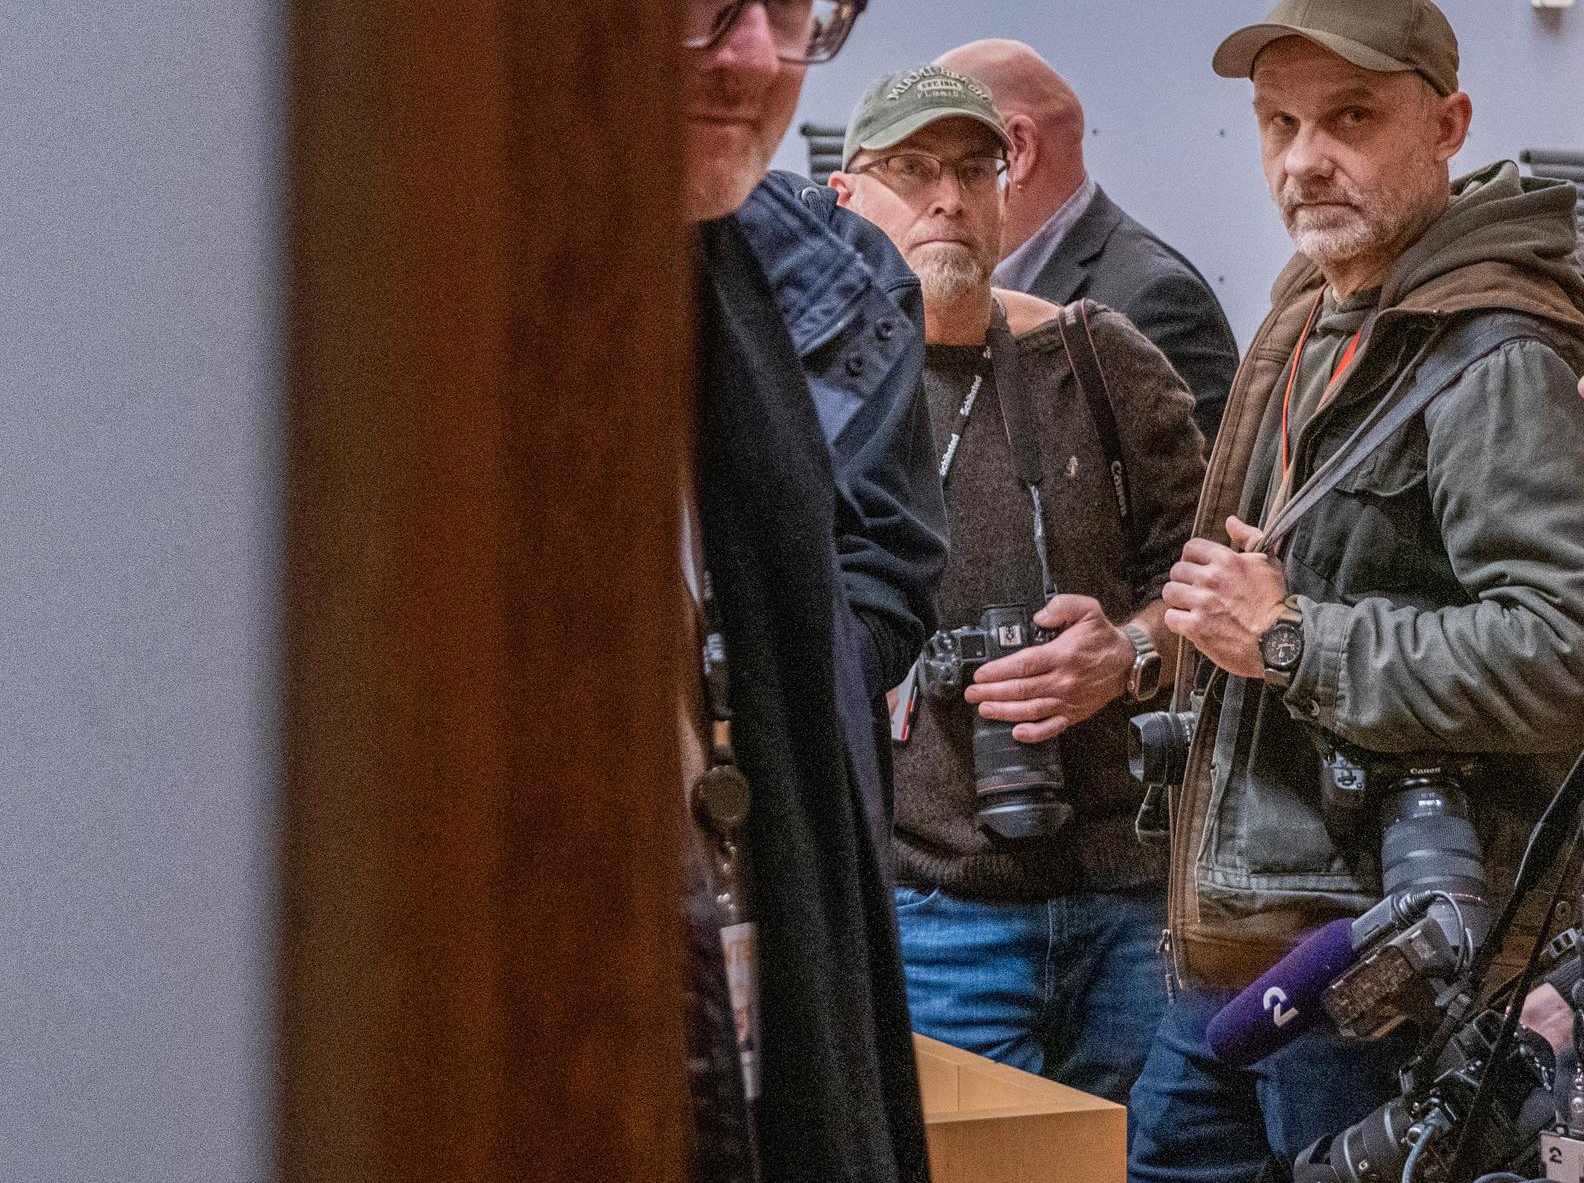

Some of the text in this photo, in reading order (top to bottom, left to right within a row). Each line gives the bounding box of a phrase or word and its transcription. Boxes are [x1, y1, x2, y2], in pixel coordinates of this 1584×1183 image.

[887, 65, 936, 99] MIAMI
[960, 374, 983, 416] Schibsted
[1409, 766, 1442, 776] Canon
[1262, 985, 1299, 1028] 2
[1549, 1146, 1563, 1164] 2
